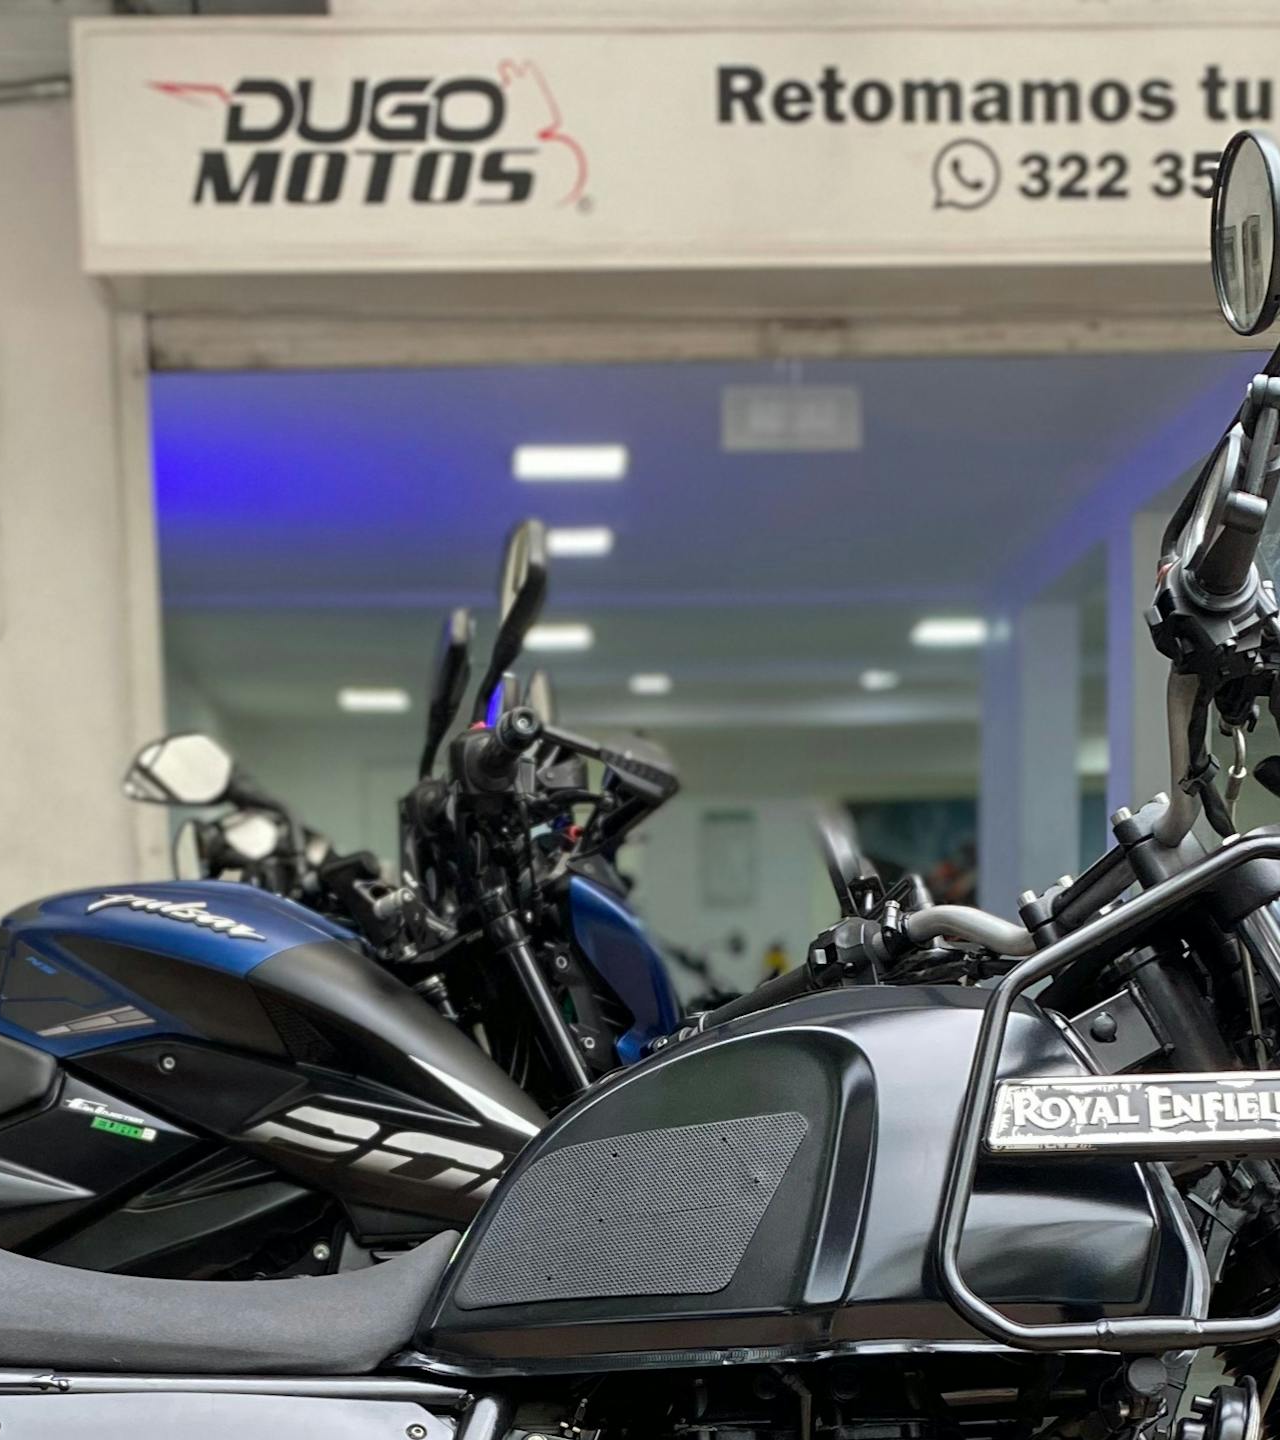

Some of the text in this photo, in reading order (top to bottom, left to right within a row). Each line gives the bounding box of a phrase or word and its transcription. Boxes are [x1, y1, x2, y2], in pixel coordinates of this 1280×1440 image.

[224, 78, 507, 144] DUGO
[716, 64, 1176, 125] Retomamos
[1201, 65, 1274, 124] tu
[191, 149, 538, 206] MOTOS
[1019, 151, 1131, 199] 322
[1012, 1088, 1140, 1131] ROYAL
